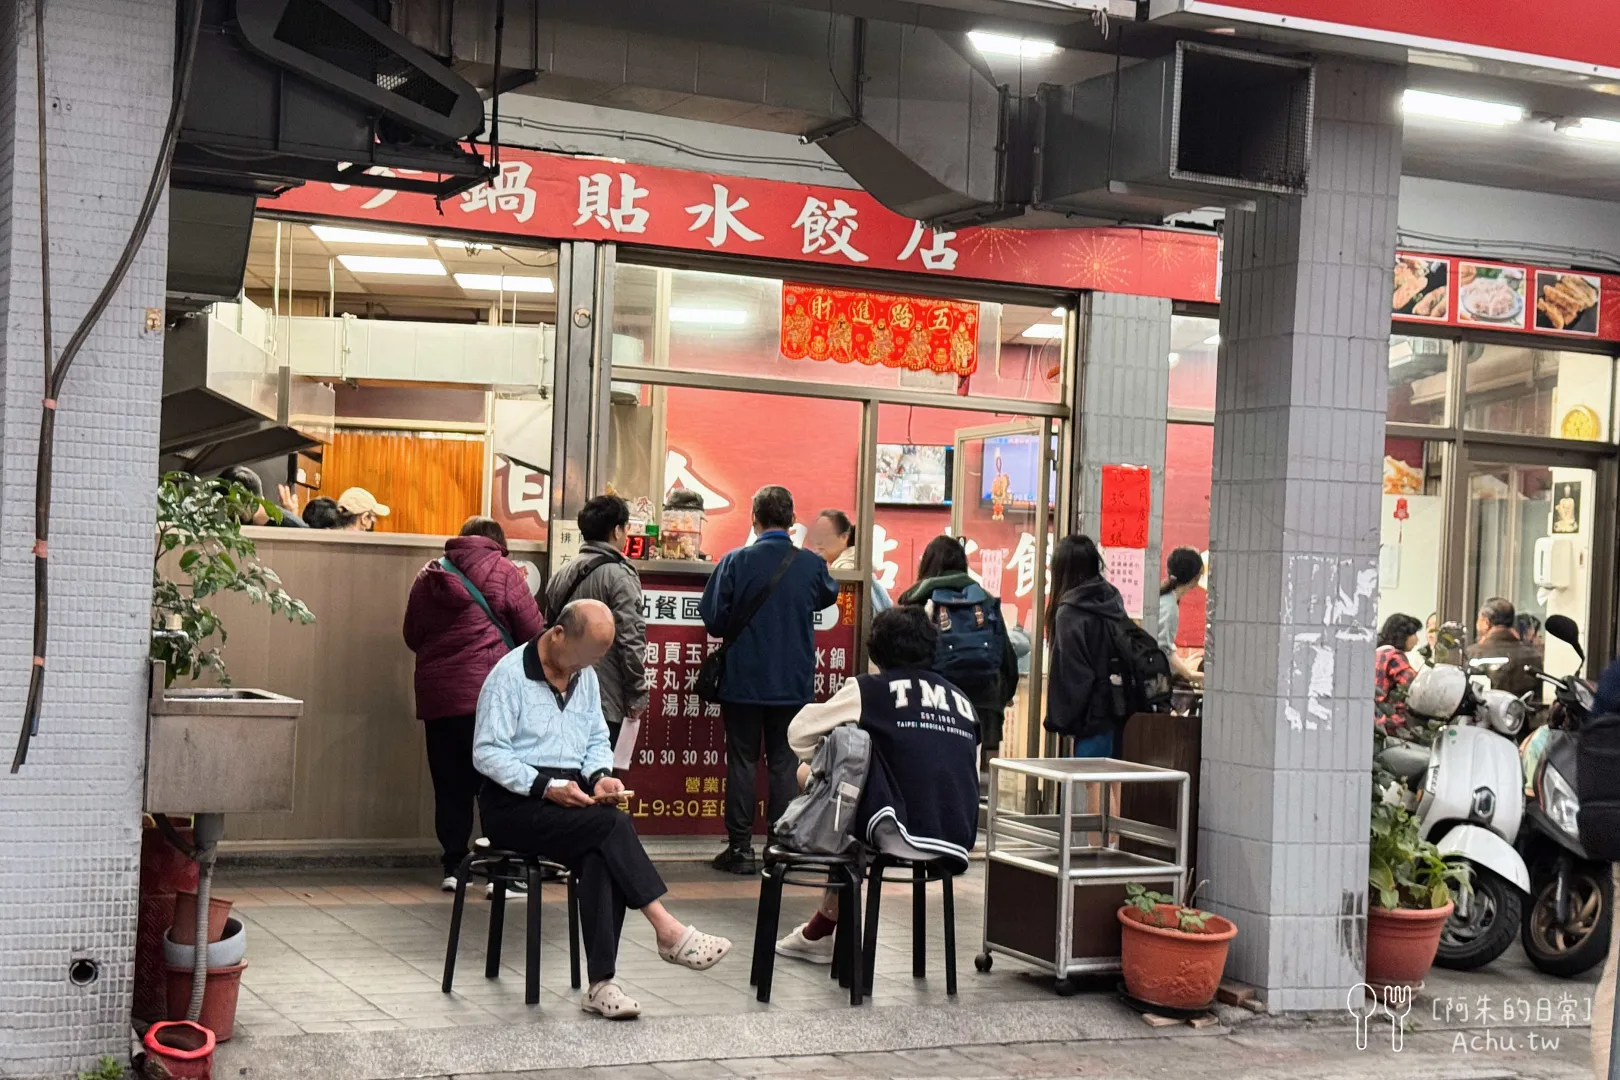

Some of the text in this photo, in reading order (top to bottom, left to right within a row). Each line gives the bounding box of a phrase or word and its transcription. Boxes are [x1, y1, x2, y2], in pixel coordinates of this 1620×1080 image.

[560, 531, 585, 545] 排
[829, 647, 846, 694] 鍋貼
[639, 641, 659, 765] 泡菜 30
[660, 641, 681, 765] 貢丸湯 30
[682, 642, 702, 765] 玉米湯 30
[896, 721, 974, 740] TAIPEI MEDICAL UNIVERSITY
[703, 749, 718, 765] 30
